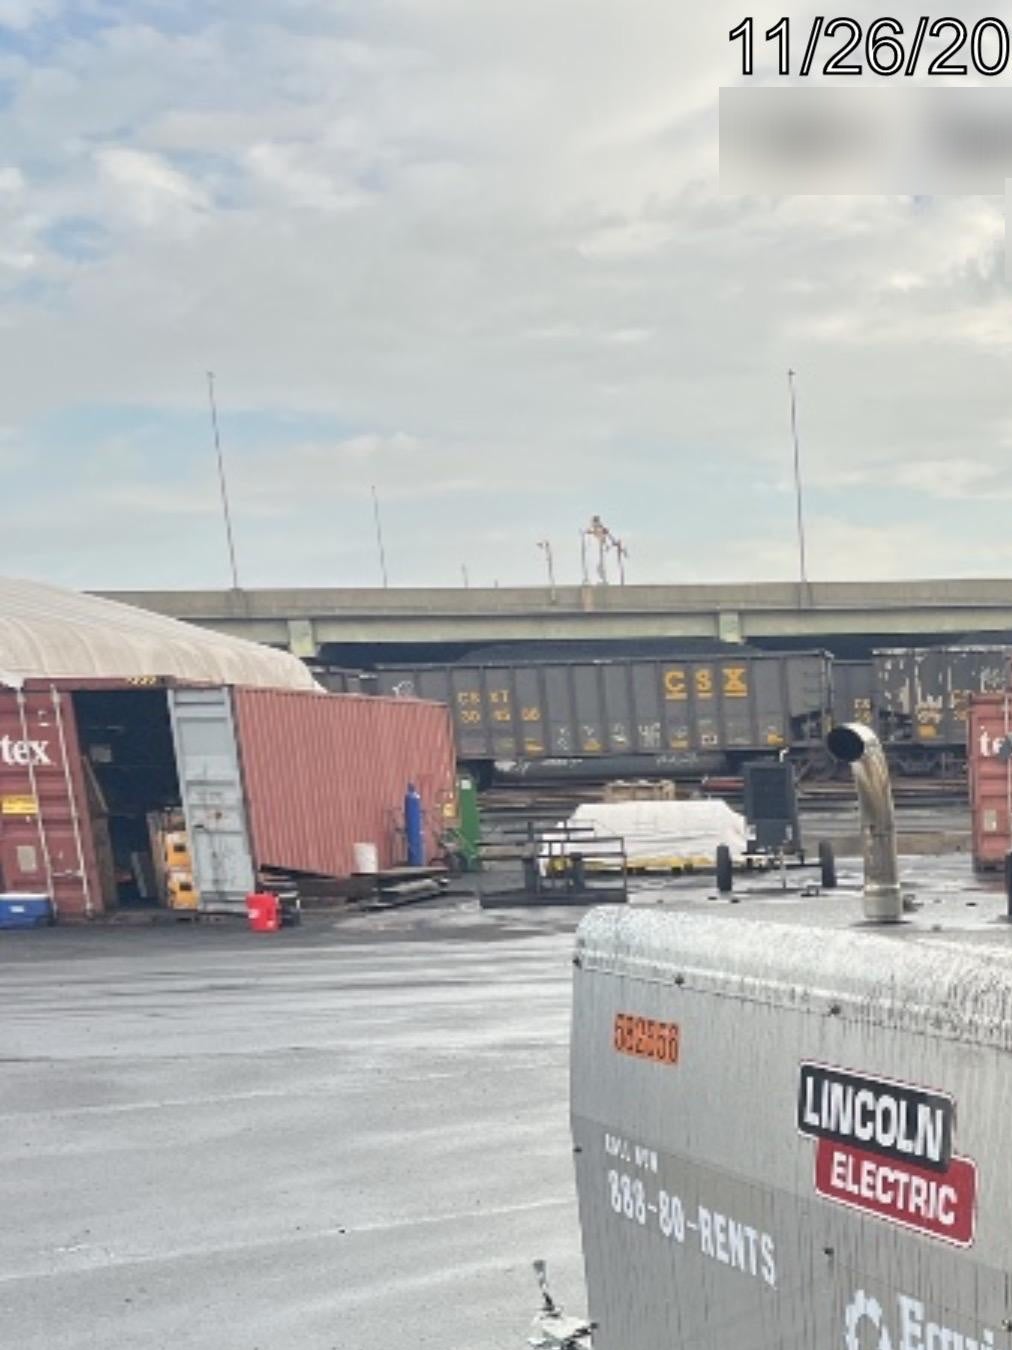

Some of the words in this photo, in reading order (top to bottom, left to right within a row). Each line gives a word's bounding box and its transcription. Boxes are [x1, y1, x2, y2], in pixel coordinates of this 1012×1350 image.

[664, 668, 747, 699] CSX
[803, 1075, 944, 1161] LINCOLN
[830, 1151, 958, 1226] ELECTRIC
[608, 1168, 776, 1290] 888-80-RENTS
